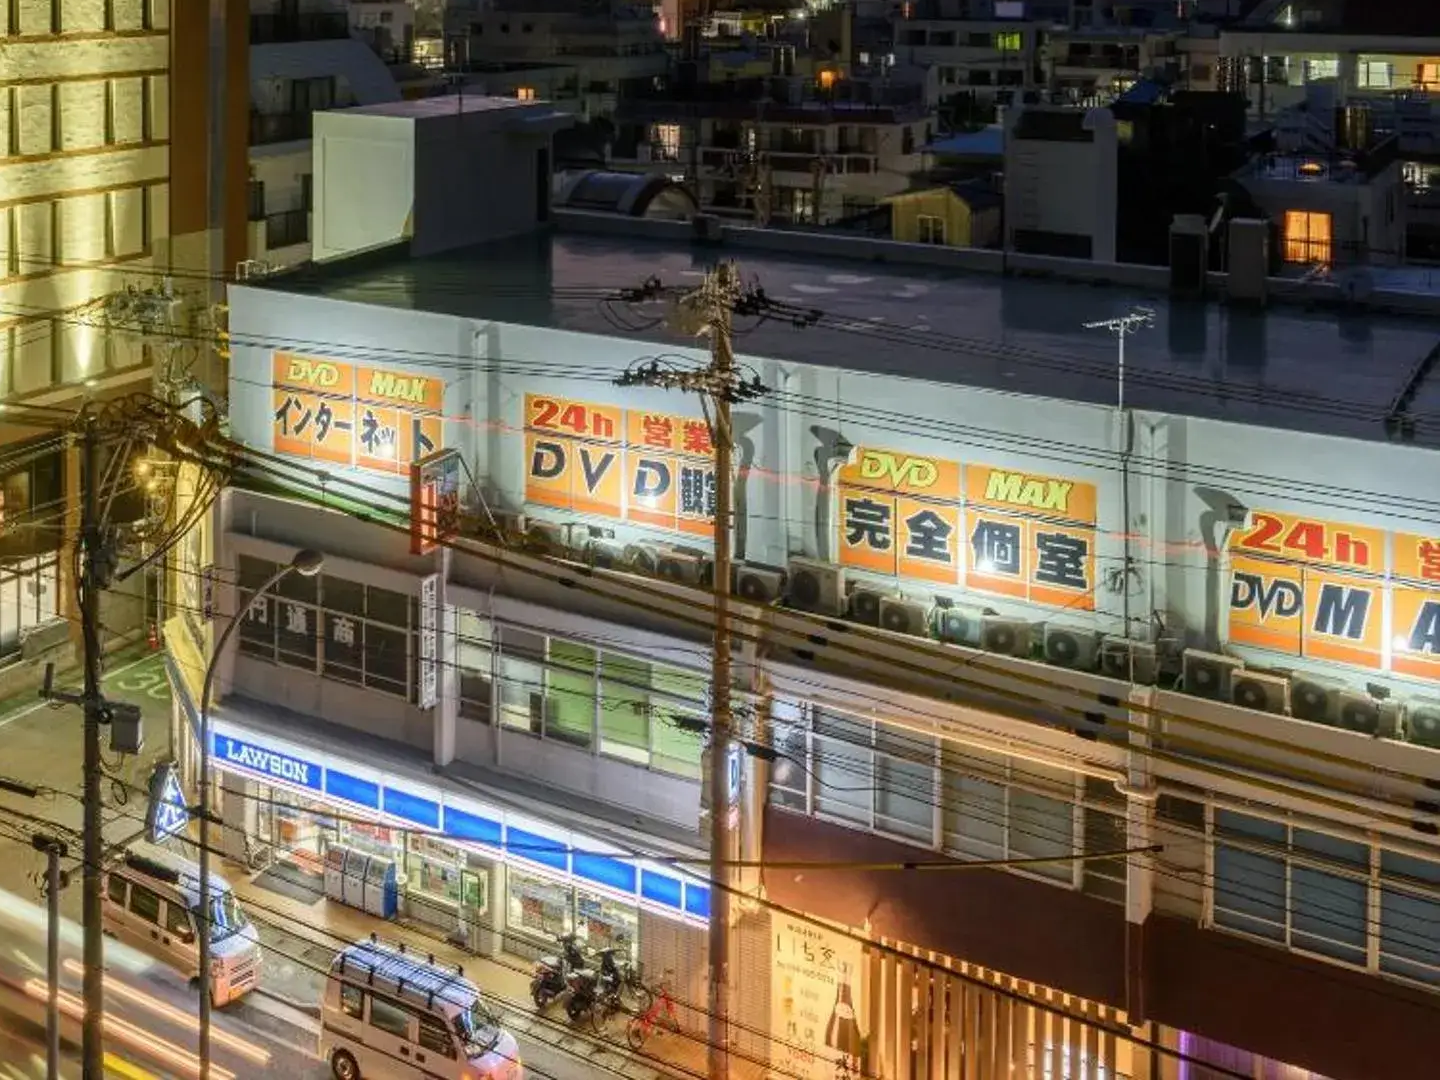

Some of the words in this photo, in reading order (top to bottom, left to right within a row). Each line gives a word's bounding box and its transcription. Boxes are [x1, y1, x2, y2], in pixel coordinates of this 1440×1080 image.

[287, 358, 339, 386] DVD
[275, 395, 435, 461] インターネット
[532, 398, 614, 438] 24h
[859, 450, 938, 488] DVD
[843, 496, 1089, 590] 完全個室
[1242, 511, 1370, 568] 24h
[1230, 570, 1304, 623] DVD
[226, 739, 309, 784] LAWSON
